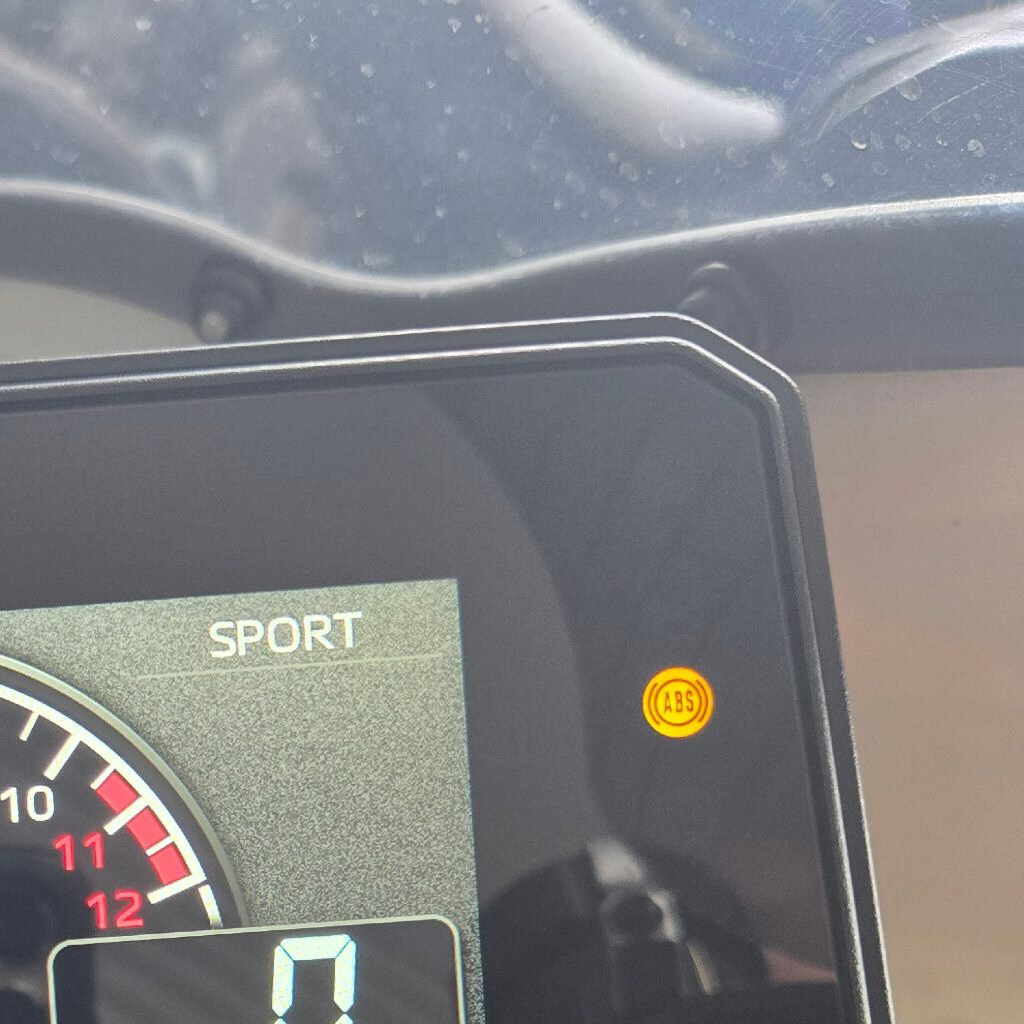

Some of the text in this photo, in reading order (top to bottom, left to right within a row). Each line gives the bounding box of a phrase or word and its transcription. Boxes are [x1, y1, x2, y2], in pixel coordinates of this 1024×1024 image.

[209, 611, 363, 658] SPORT
[663, 690, 695, 714] ABS
[0, 785, 56, 824] 10
[52, 832, 106, 872] 11
[85, 889, 145, 930] 12
